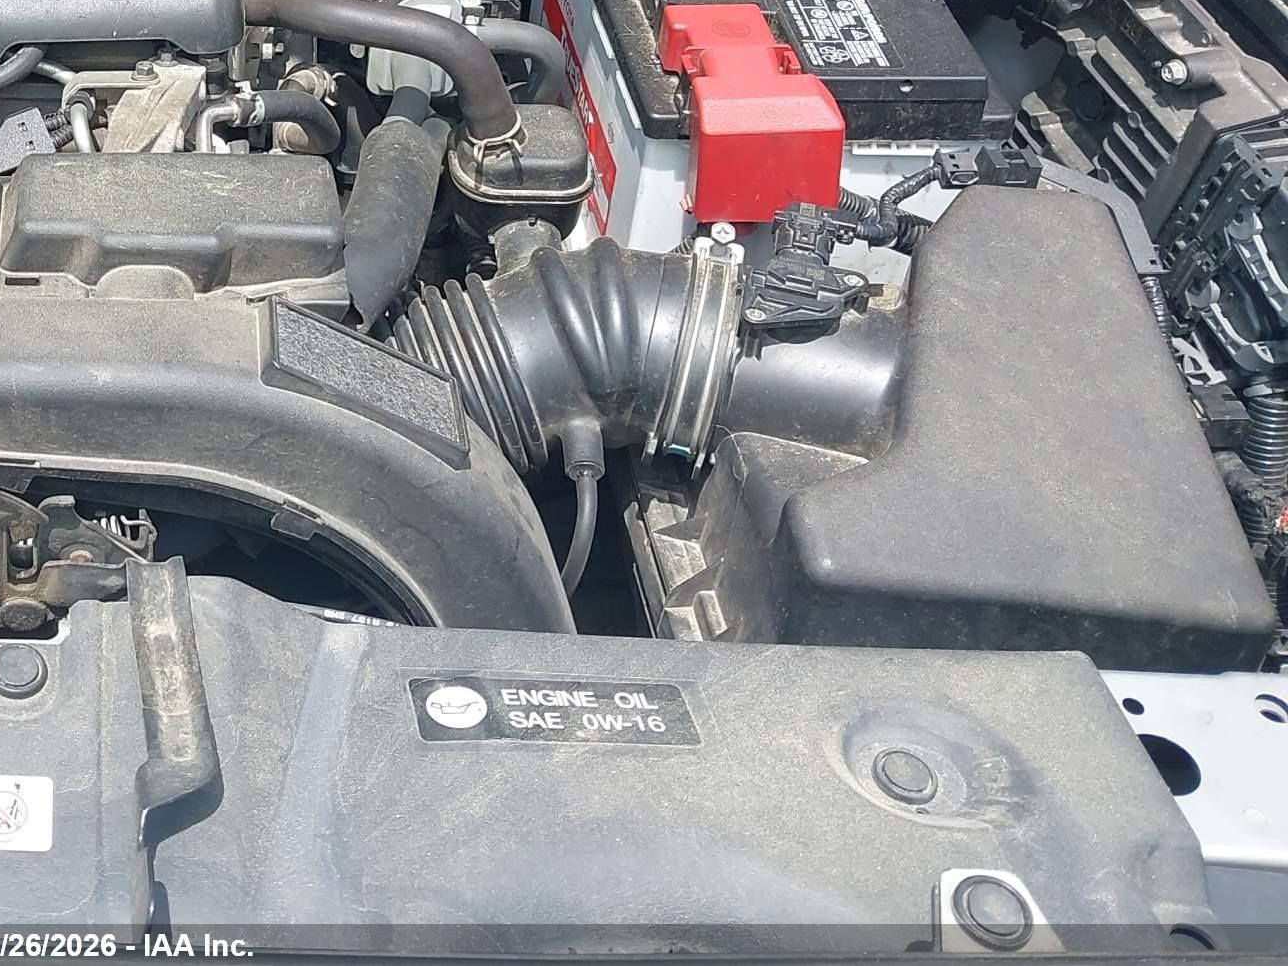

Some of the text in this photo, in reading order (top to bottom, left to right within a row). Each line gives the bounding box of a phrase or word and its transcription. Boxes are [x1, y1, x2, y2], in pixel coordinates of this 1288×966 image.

[501, 688, 659, 711] ENGINE OIL
[508, 711, 666, 733] SAE 0W-16
